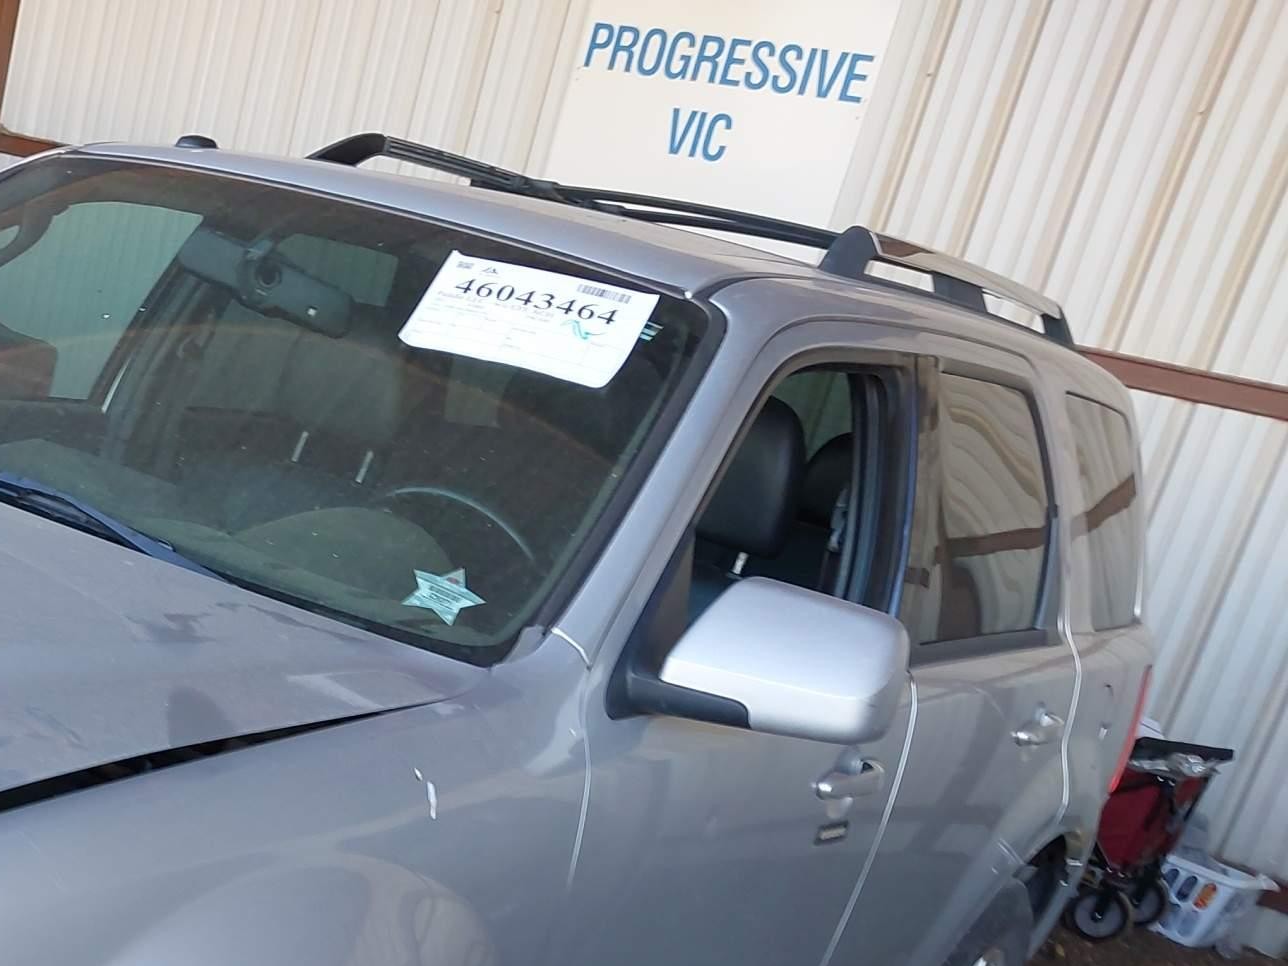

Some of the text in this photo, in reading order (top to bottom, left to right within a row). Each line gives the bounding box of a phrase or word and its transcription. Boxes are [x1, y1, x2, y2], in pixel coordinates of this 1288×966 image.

[584, 22, 874, 103] PROGRESSIVE
[668, 107, 732, 162] VIC
[455, 278, 618, 325] 46043464
